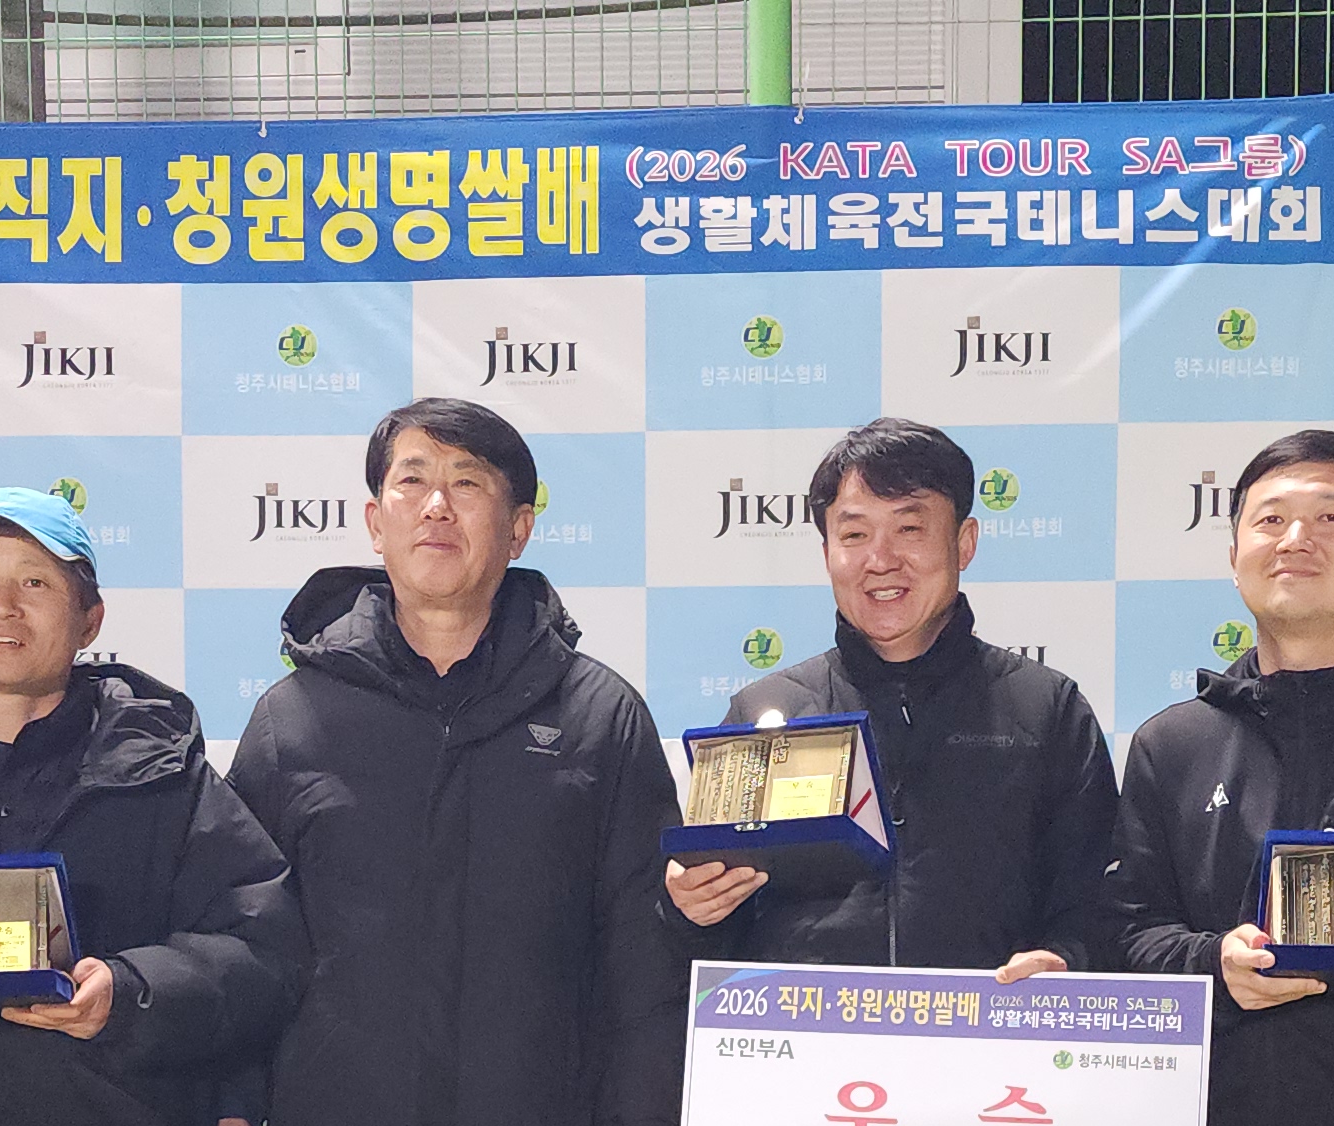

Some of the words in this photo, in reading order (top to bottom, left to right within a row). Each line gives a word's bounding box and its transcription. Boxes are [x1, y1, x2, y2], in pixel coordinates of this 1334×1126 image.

[625, 144, 746, 188] (2026
[779, 141, 917, 180] KATA
[944, 138, 1091, 176] TOUR
[1122, 134, 1307, 180] SA그룹)
[634, 185, 1321, 255] 생활체육전국테니스대회
[17, 341, 115, 388] JIKJI
[480, 339, 578, 387] JIKJI
[950, 328, 1052, 377] JIKJI
[1174, 355, 1300, 378] 청주시테니스협회
[235, 372, 360, 393] 청주시테니스협회
[701, 363, 827, 386] 청주시테니스협회
[250, 496, 348, 542] JIKJI
[713, 491, 813, 539] JIKJI
[715, 986, 769, 1016] 2026
[777, 986, 980, 1026] 직지·청원생명쌀배
[988, 1009, 1182, 1032] 생활체육전국테니스대회
[990, 994, 1024, 1008] (2026
[1031, 995, 1070, 1009] KATA
[1078, 996, 1118, 1011] TOUR
[1126, 997, 1180, 1014] SA그룹)
[716, 1037, 795, 1060] 신인부A
[1079, 1053, 1178, 1071] 청주시테니스협회
